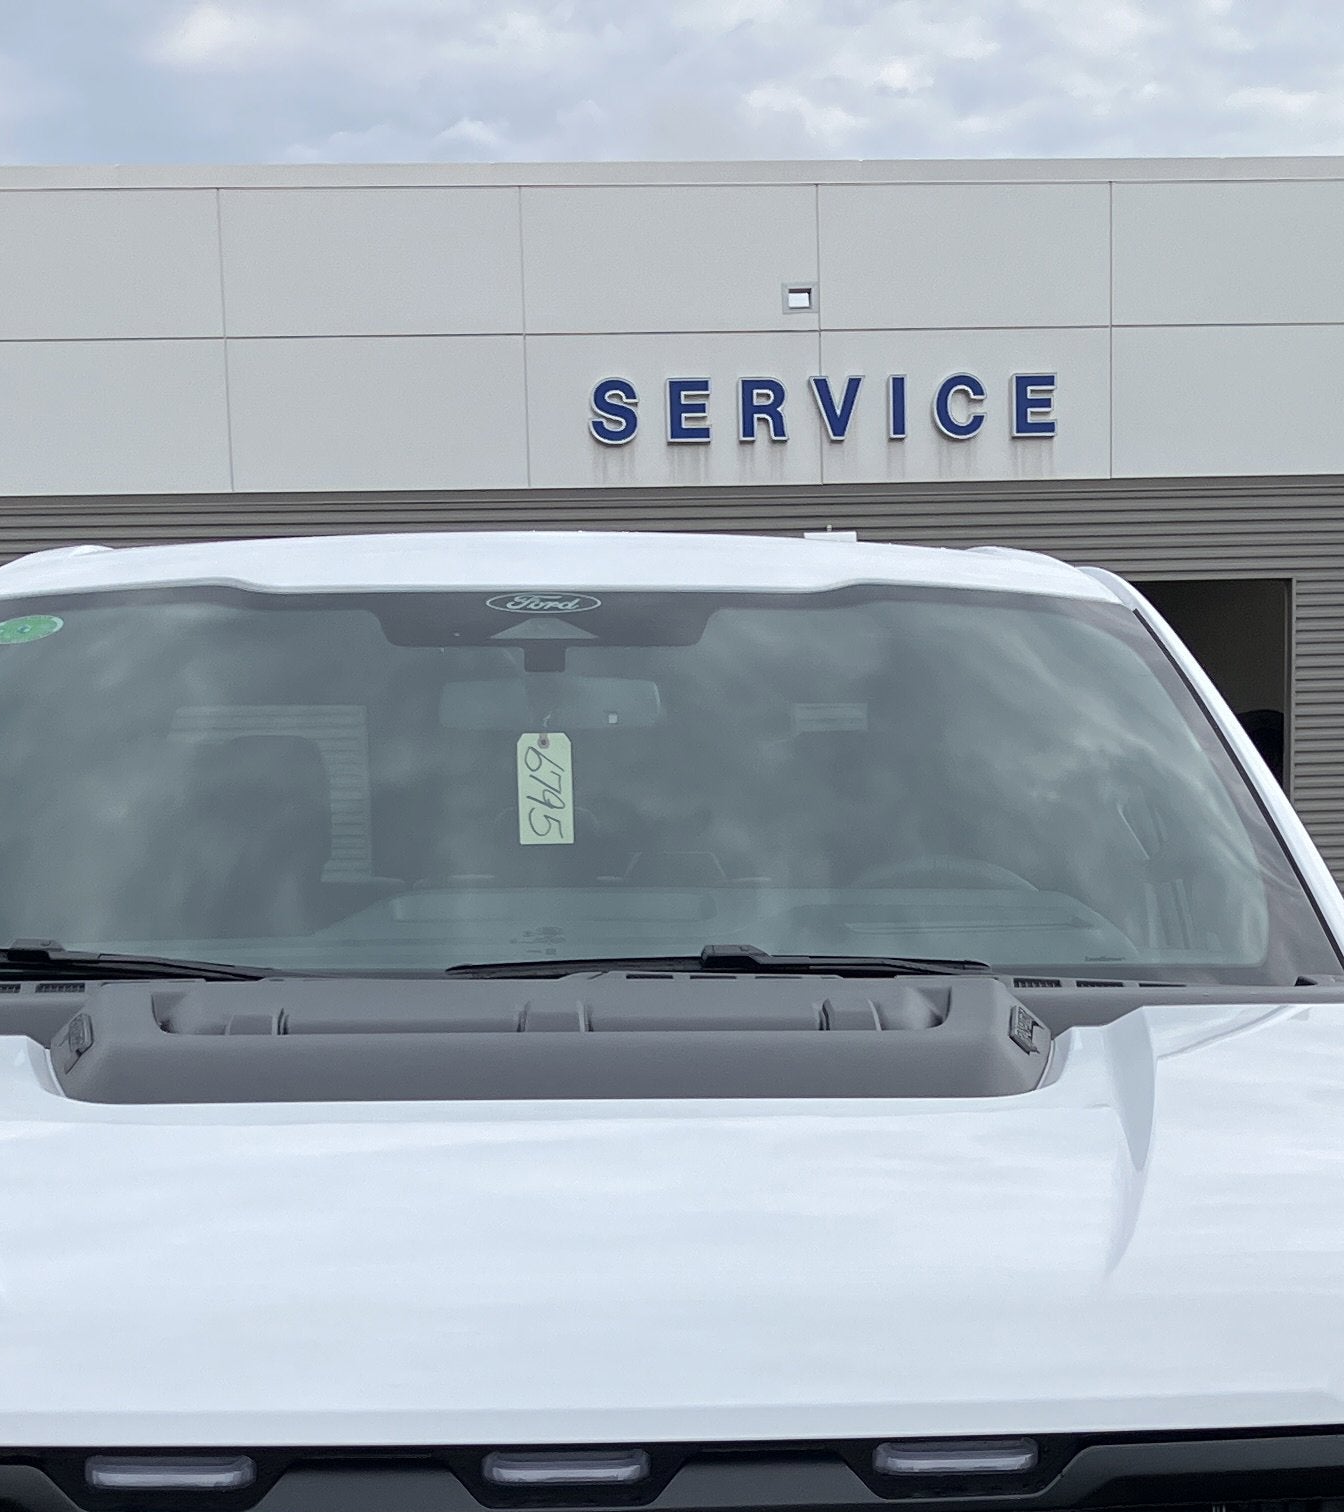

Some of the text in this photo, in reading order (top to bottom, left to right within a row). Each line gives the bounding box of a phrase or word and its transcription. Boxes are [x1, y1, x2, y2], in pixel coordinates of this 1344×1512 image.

[590, 373, 1057, 446] SERVICE
[506, 595, 579, 610] Ford
[524, 746, 566, 838] 6795
